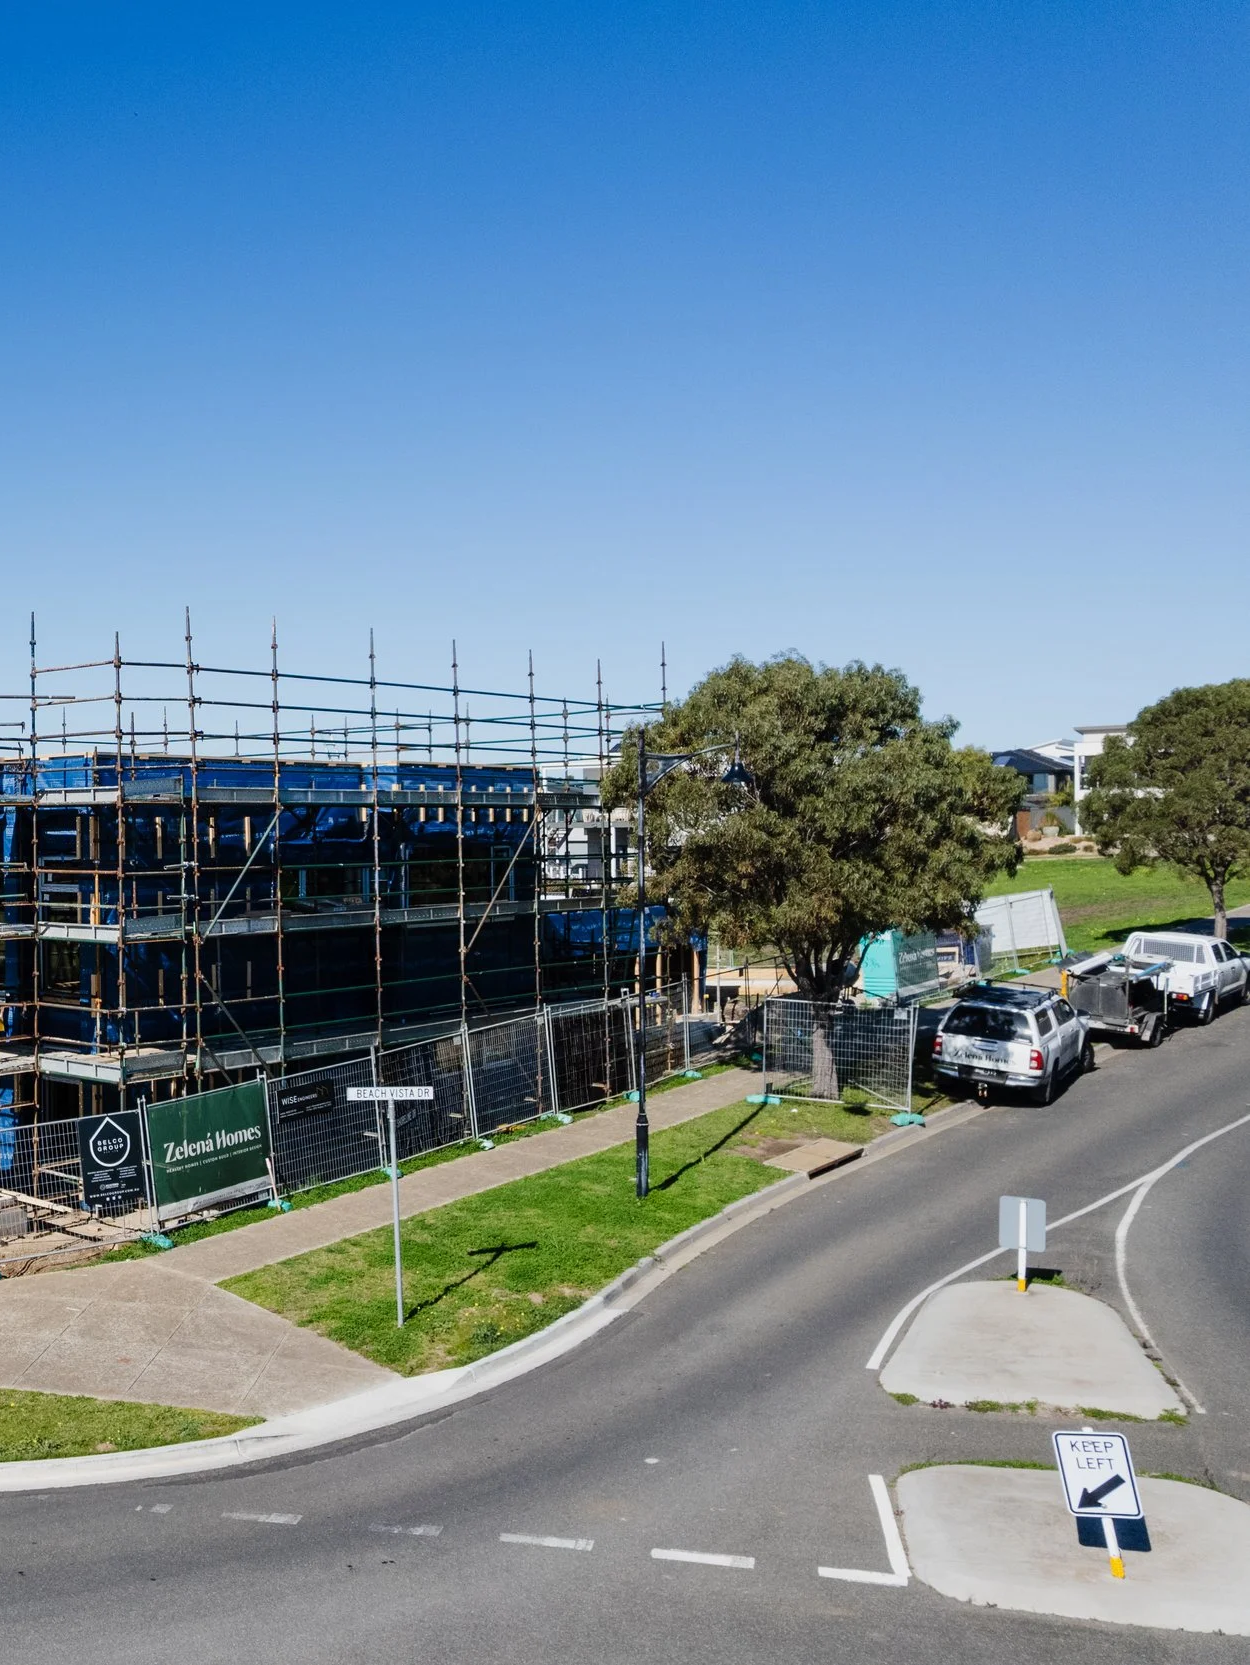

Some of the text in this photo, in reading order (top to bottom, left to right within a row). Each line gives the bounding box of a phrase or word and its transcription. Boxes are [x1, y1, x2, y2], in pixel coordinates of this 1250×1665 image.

[356, 1087, 430, 1099] BEACH VISTA DR
[97, 1137, 123, 1146] BELCO
[97, 1143, 124, 1152] GROUP
[163, 1125, 262, 1164] Zelená Homes
[1069, 1440, 1114, 1453] KEEP
[1075, 1457, 1115, 1470] LEFT
